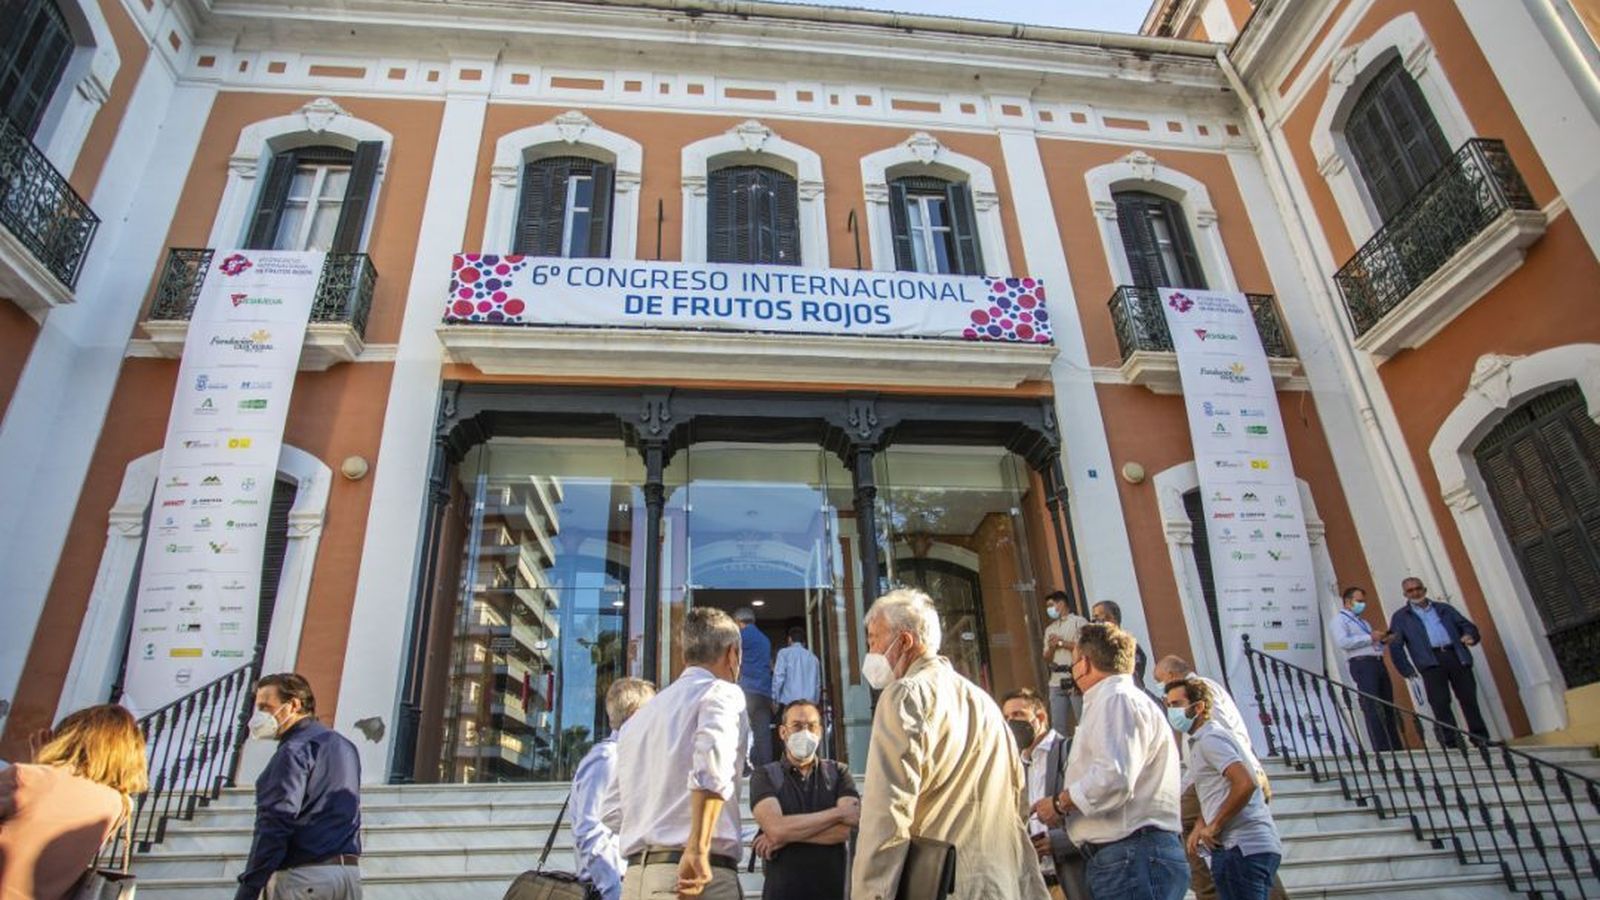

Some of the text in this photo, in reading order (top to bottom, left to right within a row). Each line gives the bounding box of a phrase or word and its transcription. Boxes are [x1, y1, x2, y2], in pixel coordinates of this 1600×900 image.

[532, 265, 975, 303] 6º CONGRESO INTERNACIONAL
[625, 294, 892, 328] DE FRUTOS ROJOS
